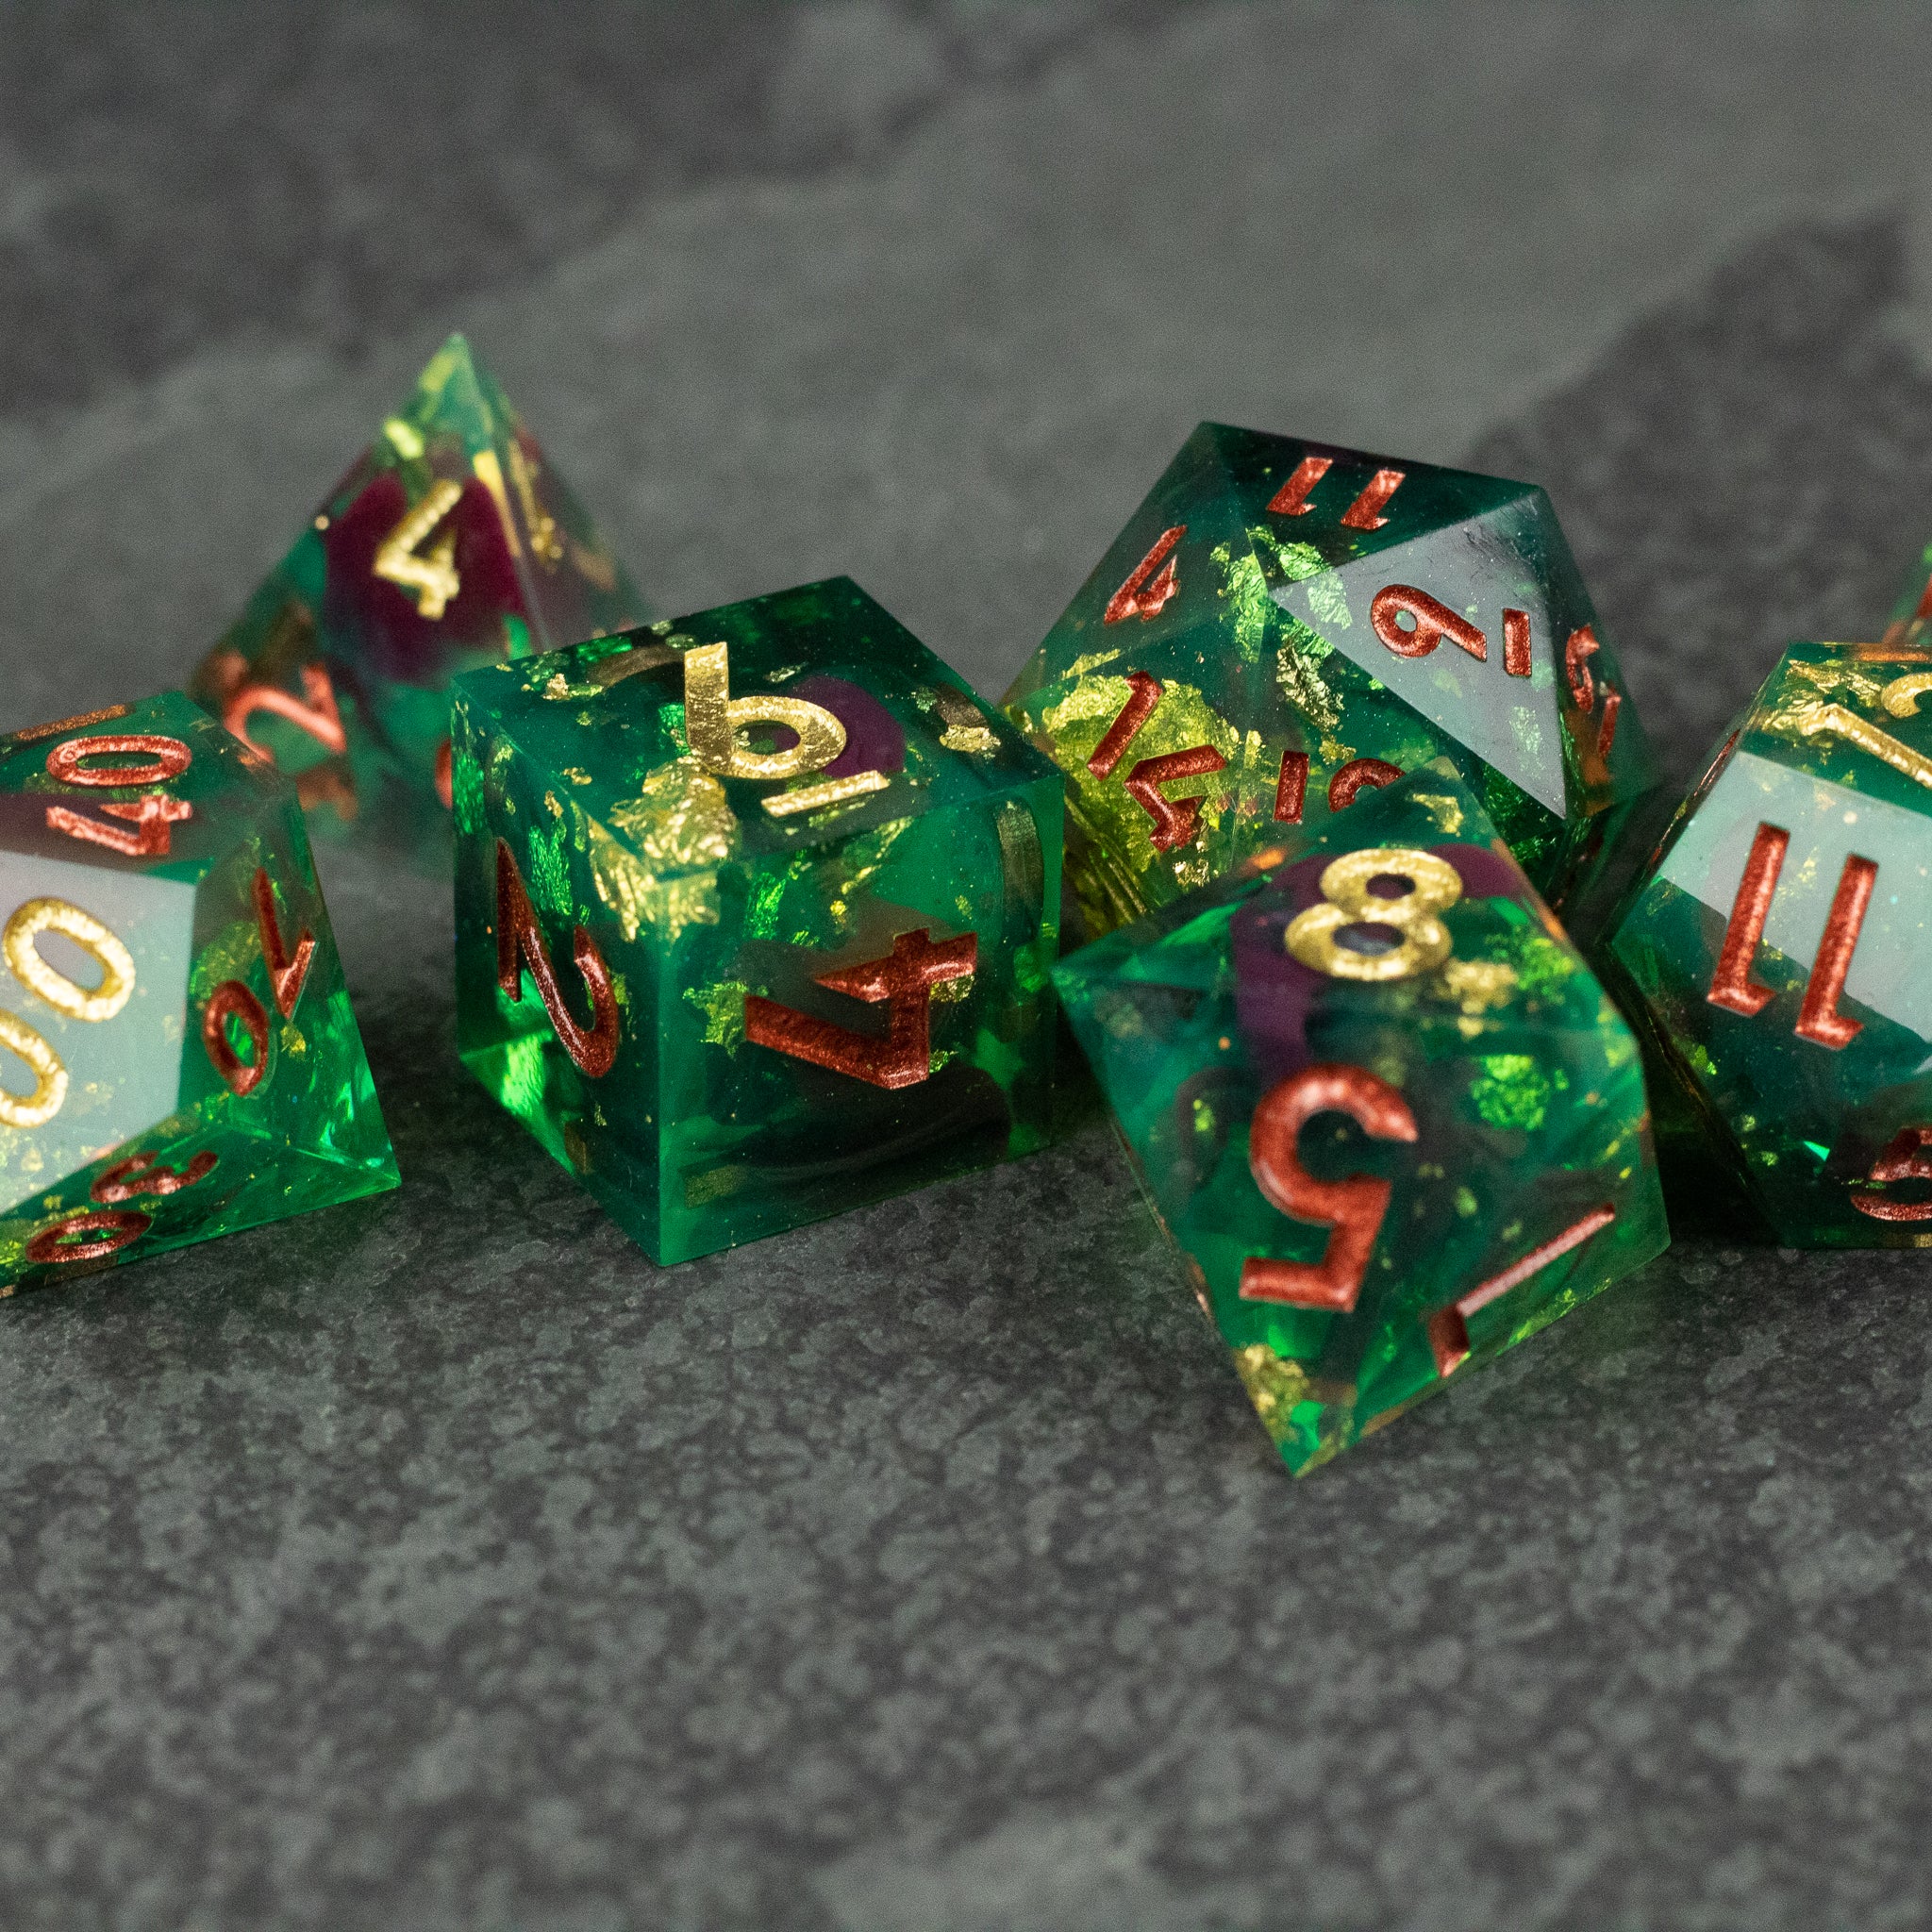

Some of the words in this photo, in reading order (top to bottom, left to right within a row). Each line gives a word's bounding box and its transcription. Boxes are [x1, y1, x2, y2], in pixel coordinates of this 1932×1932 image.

[375, 478, 464, 620] 4
[1267, 456, 1406, 530] 11
[1103, 525, 1188, 625] 4
[497, 837, 620, 1076] 2
[1285, 848, 1463, 981] 8
[1707, 821, 1879, 1051] 11
[745, 928, 978, 1090] 4
[1239, 1063, 1418, 1312] 5
